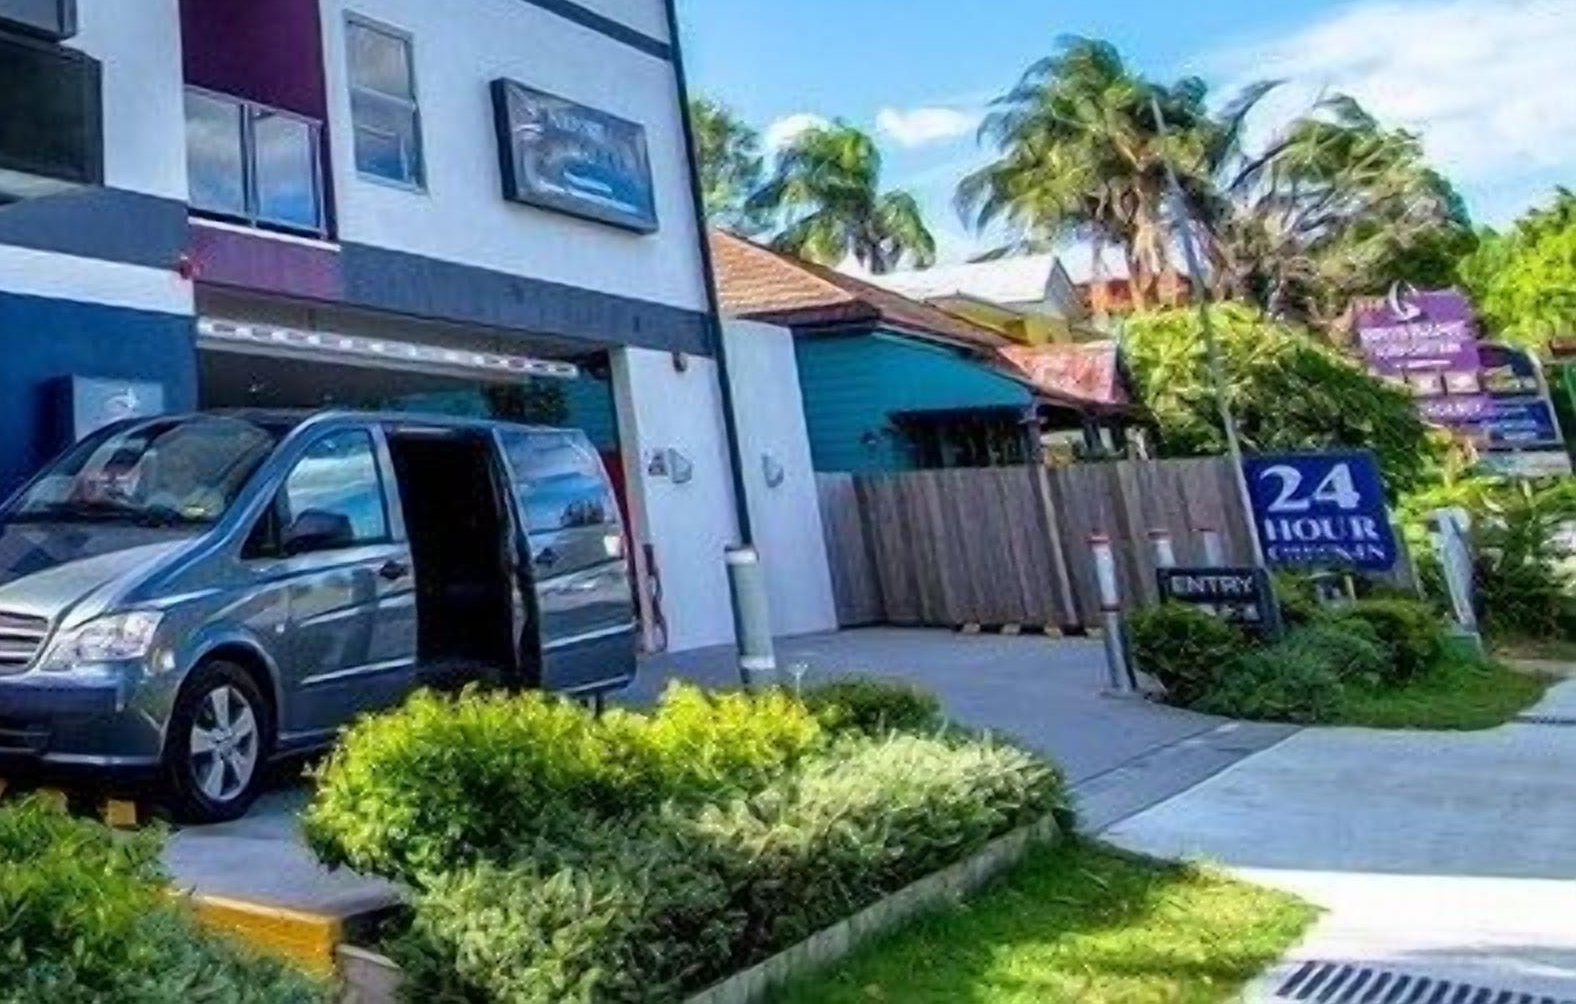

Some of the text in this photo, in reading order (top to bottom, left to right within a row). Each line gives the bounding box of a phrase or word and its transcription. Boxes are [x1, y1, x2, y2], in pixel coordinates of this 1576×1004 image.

[1259, 461, 1362, 513] 24
[1263, 515, 1380, 542] HOUR
[1170, 575, 1253, 594] ENTRY
